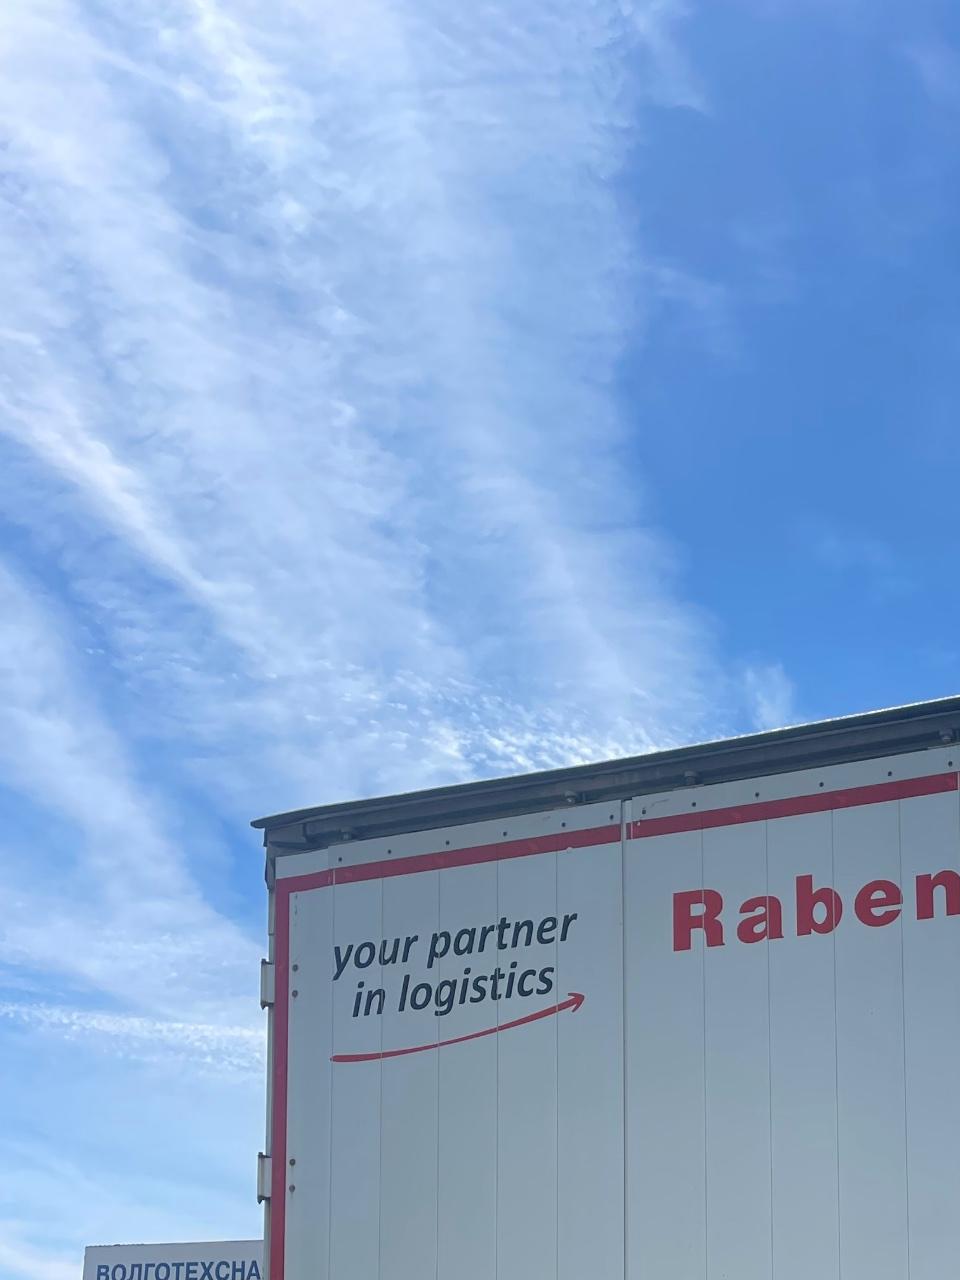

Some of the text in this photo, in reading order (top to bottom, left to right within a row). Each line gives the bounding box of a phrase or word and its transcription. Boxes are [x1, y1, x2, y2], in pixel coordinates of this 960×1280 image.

[332, 913, 577, 981] your partner
[352, 966, 555, 1018] in logistics
